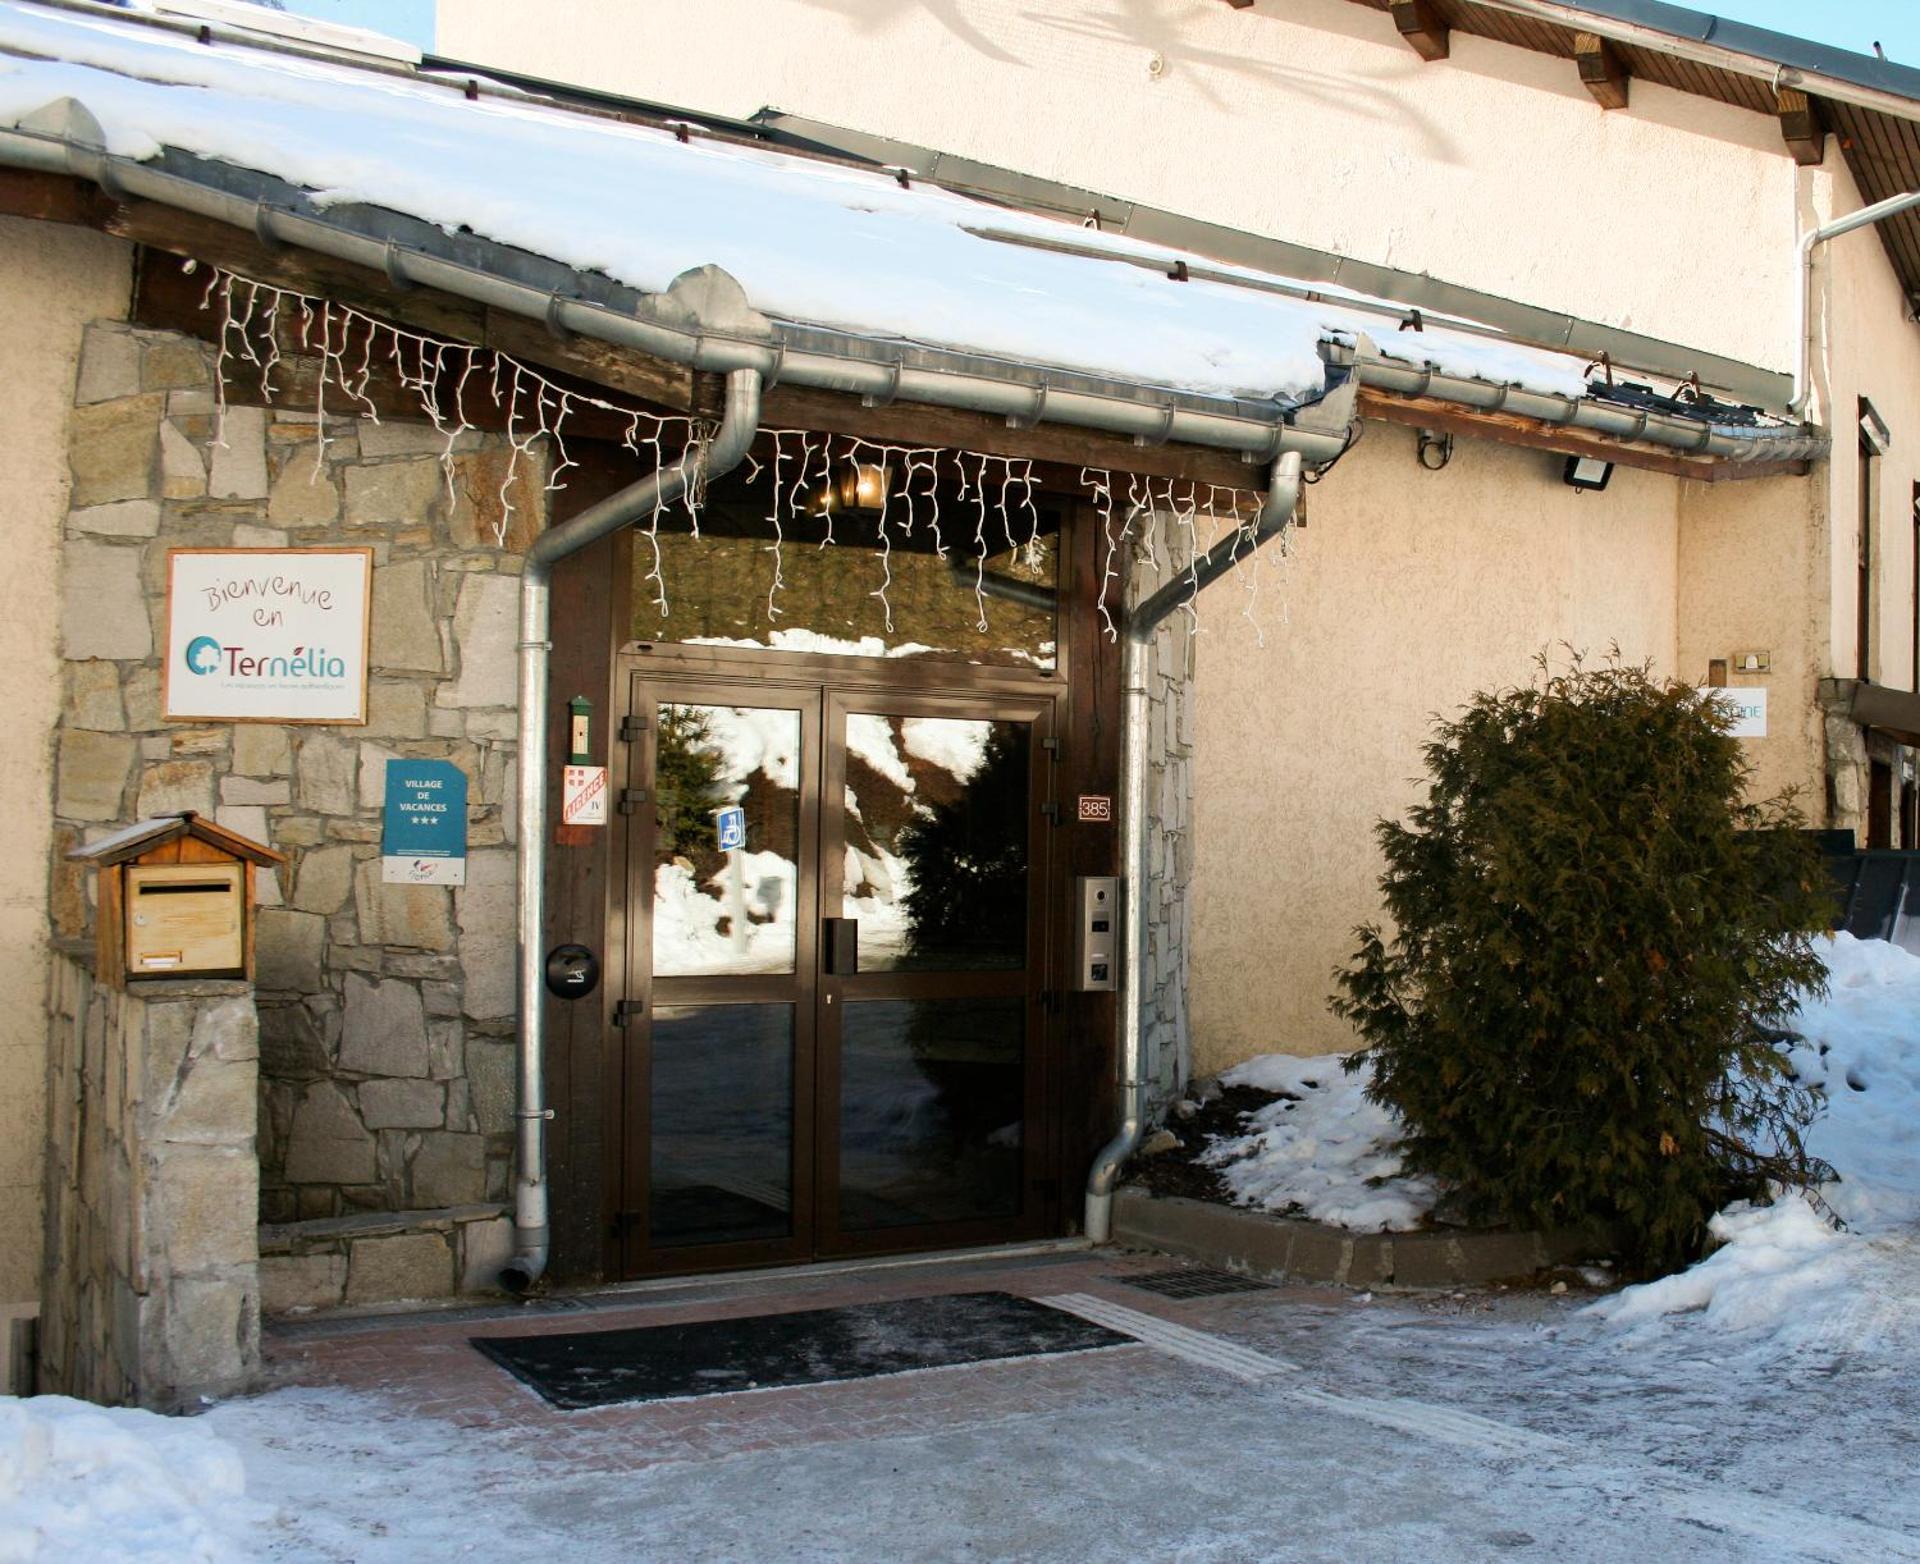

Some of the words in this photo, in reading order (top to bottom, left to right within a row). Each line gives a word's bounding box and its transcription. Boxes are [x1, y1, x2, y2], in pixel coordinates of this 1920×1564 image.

[201, 576, 333, 612] Bienvenue
[253, 608, 284, 627] en
[223, 646, 345, 678] Ternélia
[405, 780, 443, 789] VILLAGE
[417, 792, 430, 800] DE
[400, 803, 448, 812] VACANCES
[1081, 801, 1108, 816] 385
